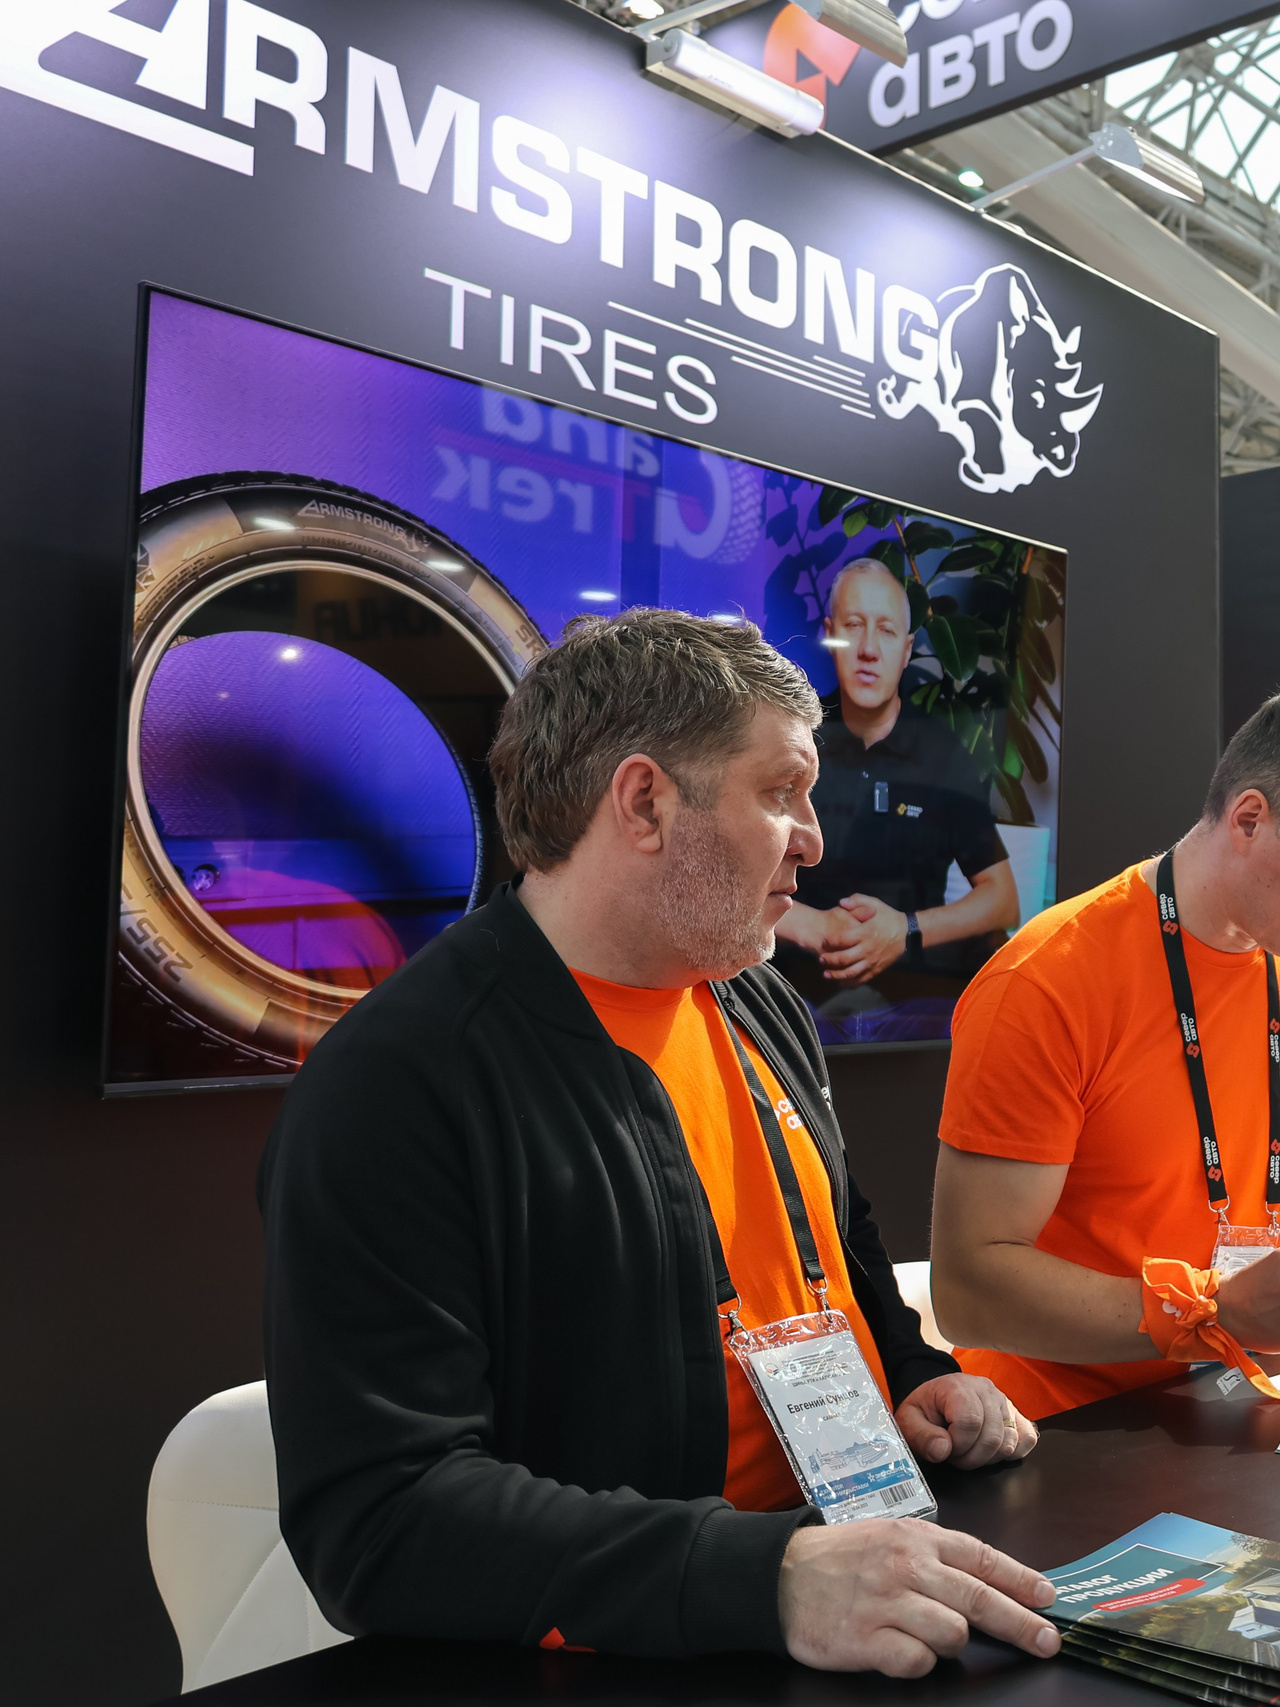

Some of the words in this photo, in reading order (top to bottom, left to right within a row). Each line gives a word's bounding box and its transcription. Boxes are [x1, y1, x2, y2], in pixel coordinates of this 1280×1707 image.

[868, 0, 1074, 127] авто
[424, 267, 718, 425] TIRES
[297, 499, 407, 536] ARMSTRONG
[1159, 893, 1168, 920] север
[1167, 897, 1176, 919] авто
[1181, 1012, 1191, 1042] север
[1188, 1017, 1198, 1041] авто
[1203, 1136, 1213, 1166] север
[1210, 1141, 1219, 1164] авто
[786, 1397, 825, 1415] Евгений
[1055, 1574, 1119, 1595] АТАЛОГ
[1058, 1567, 1175, 1604] ПРОДУКЦИИ
